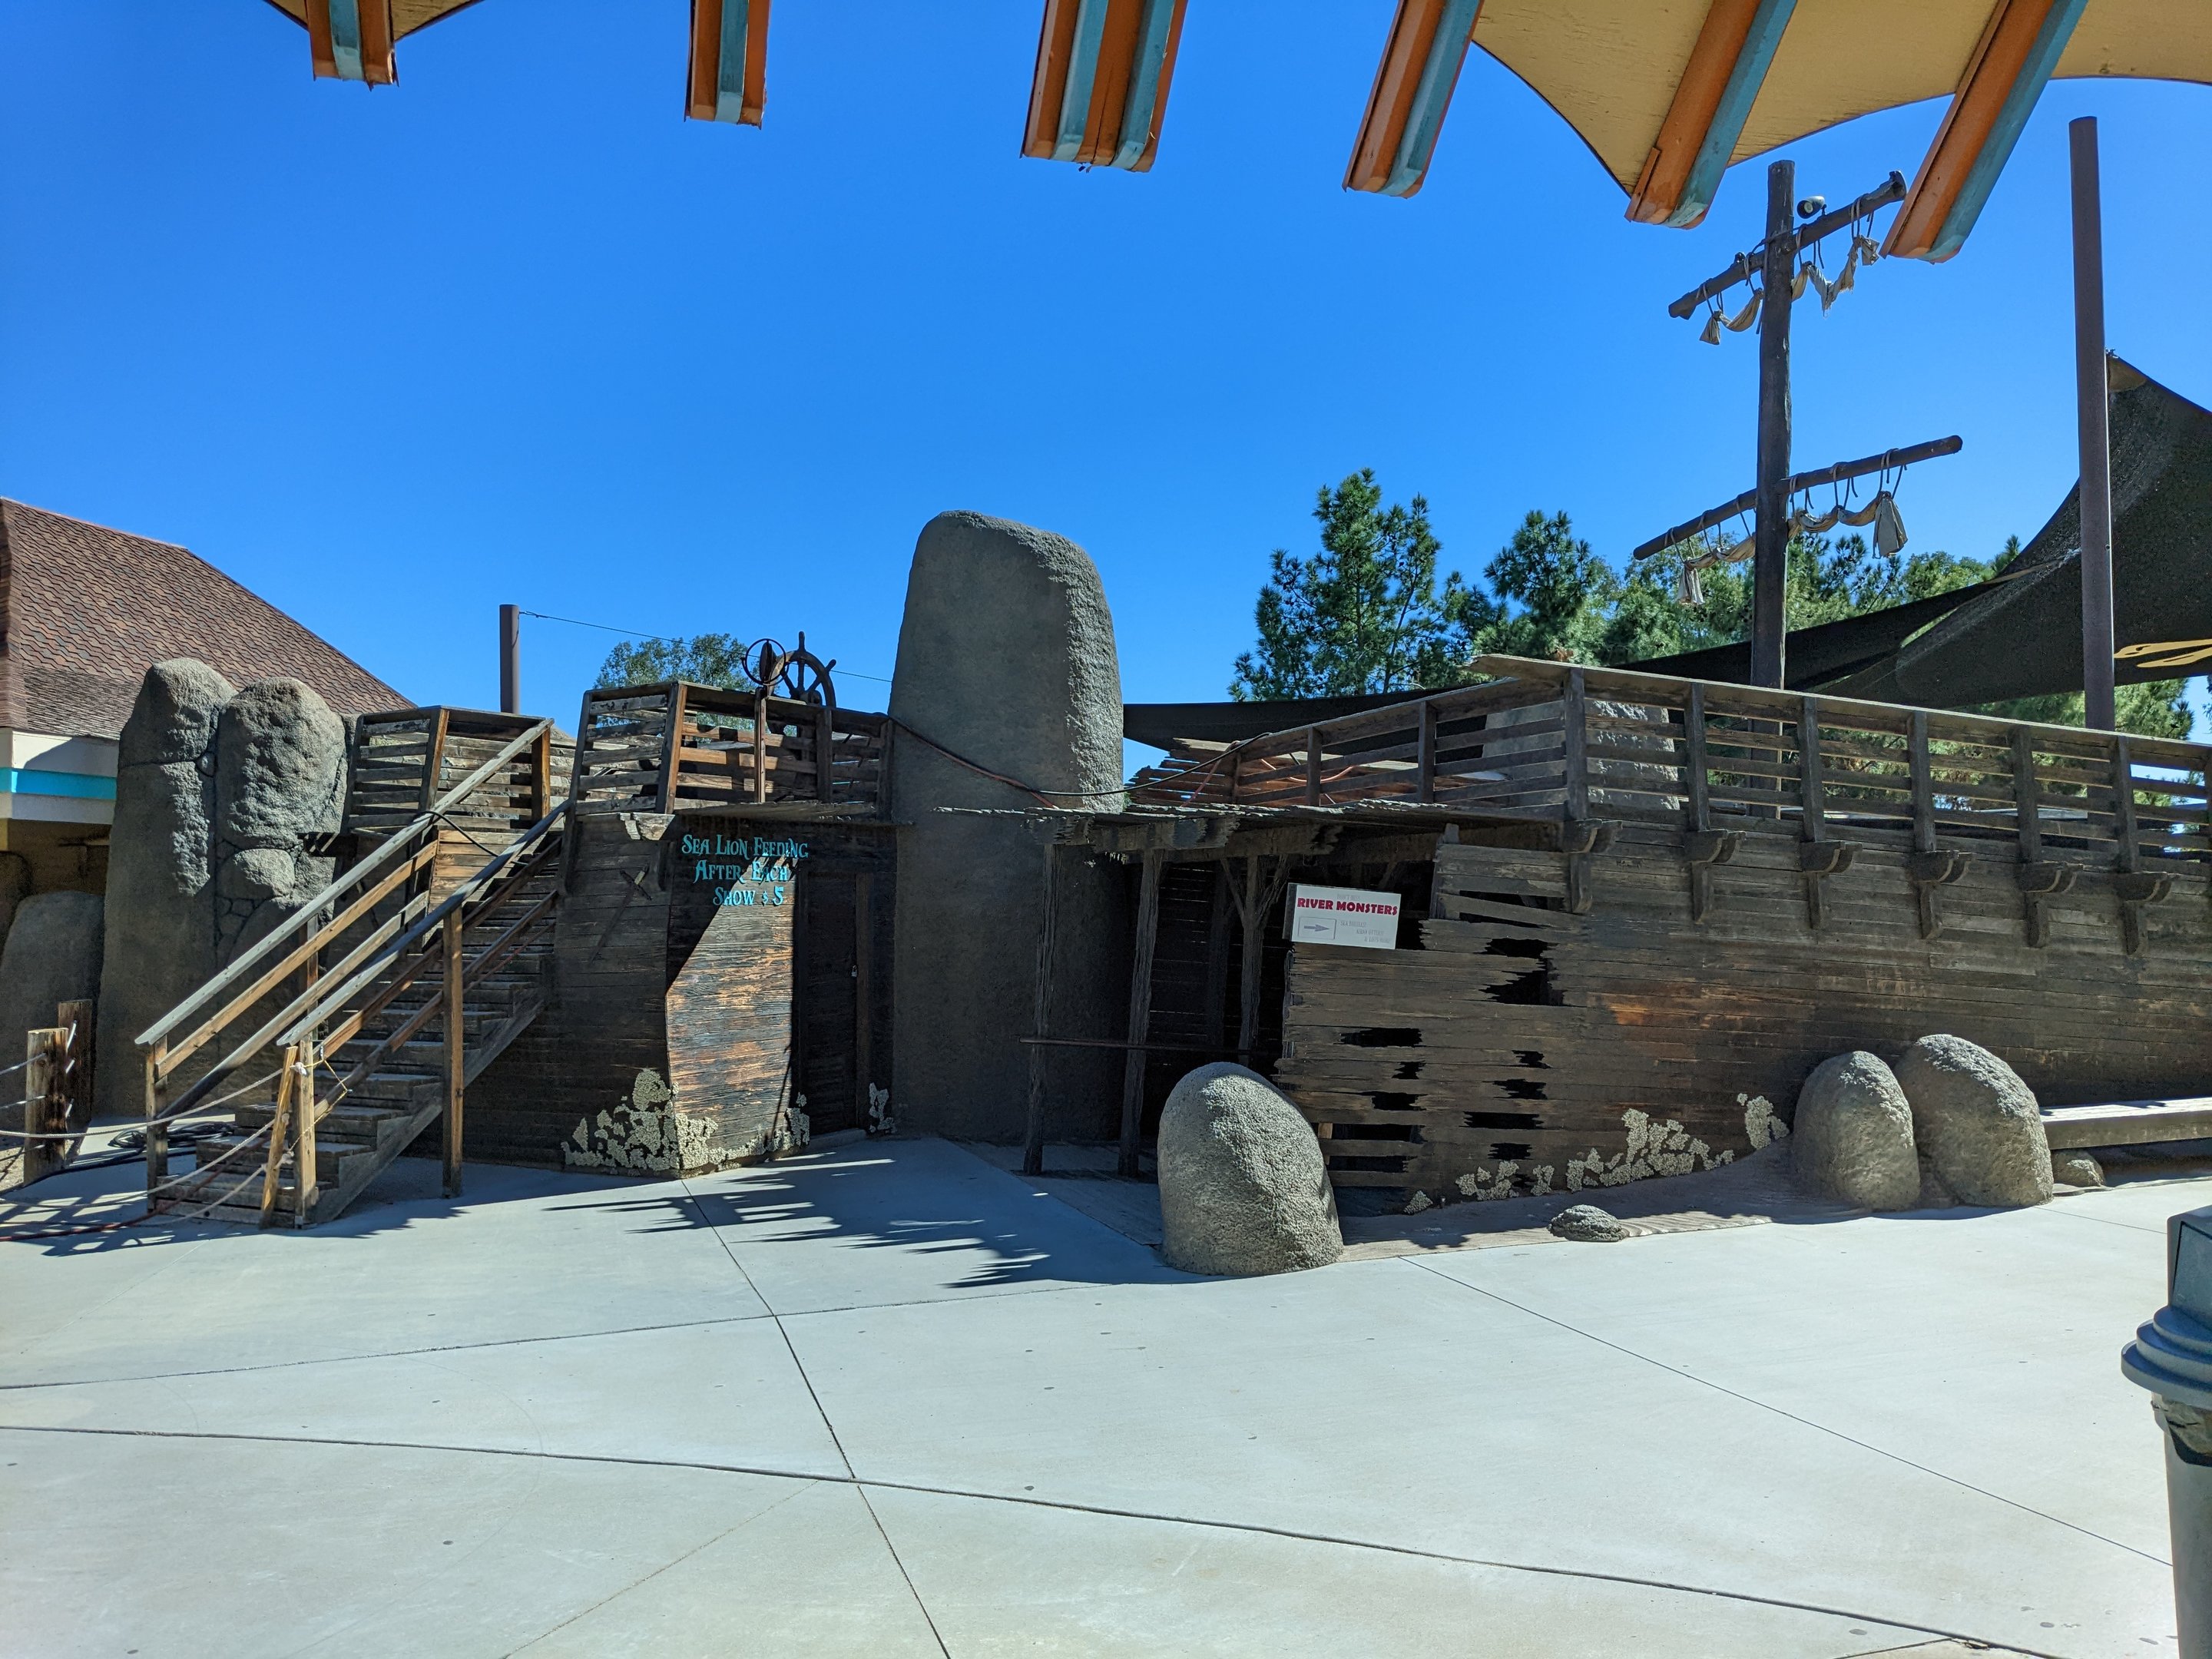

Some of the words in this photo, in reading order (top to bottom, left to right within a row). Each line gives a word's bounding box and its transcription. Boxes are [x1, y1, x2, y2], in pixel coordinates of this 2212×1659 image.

[682, 835, 710, 855] SEA
[715, 835, 750, 860] LION
[753, 837, 809, 859] FEEDING
[694, 859, 747, 883] AFTER
[752, 860, 788, 883] EACH
[713, 887, 756, 906] SHOW
[1297, 897, 1333, 910] RIVER
[1336, 901, 1398, 916] MONSTERS
